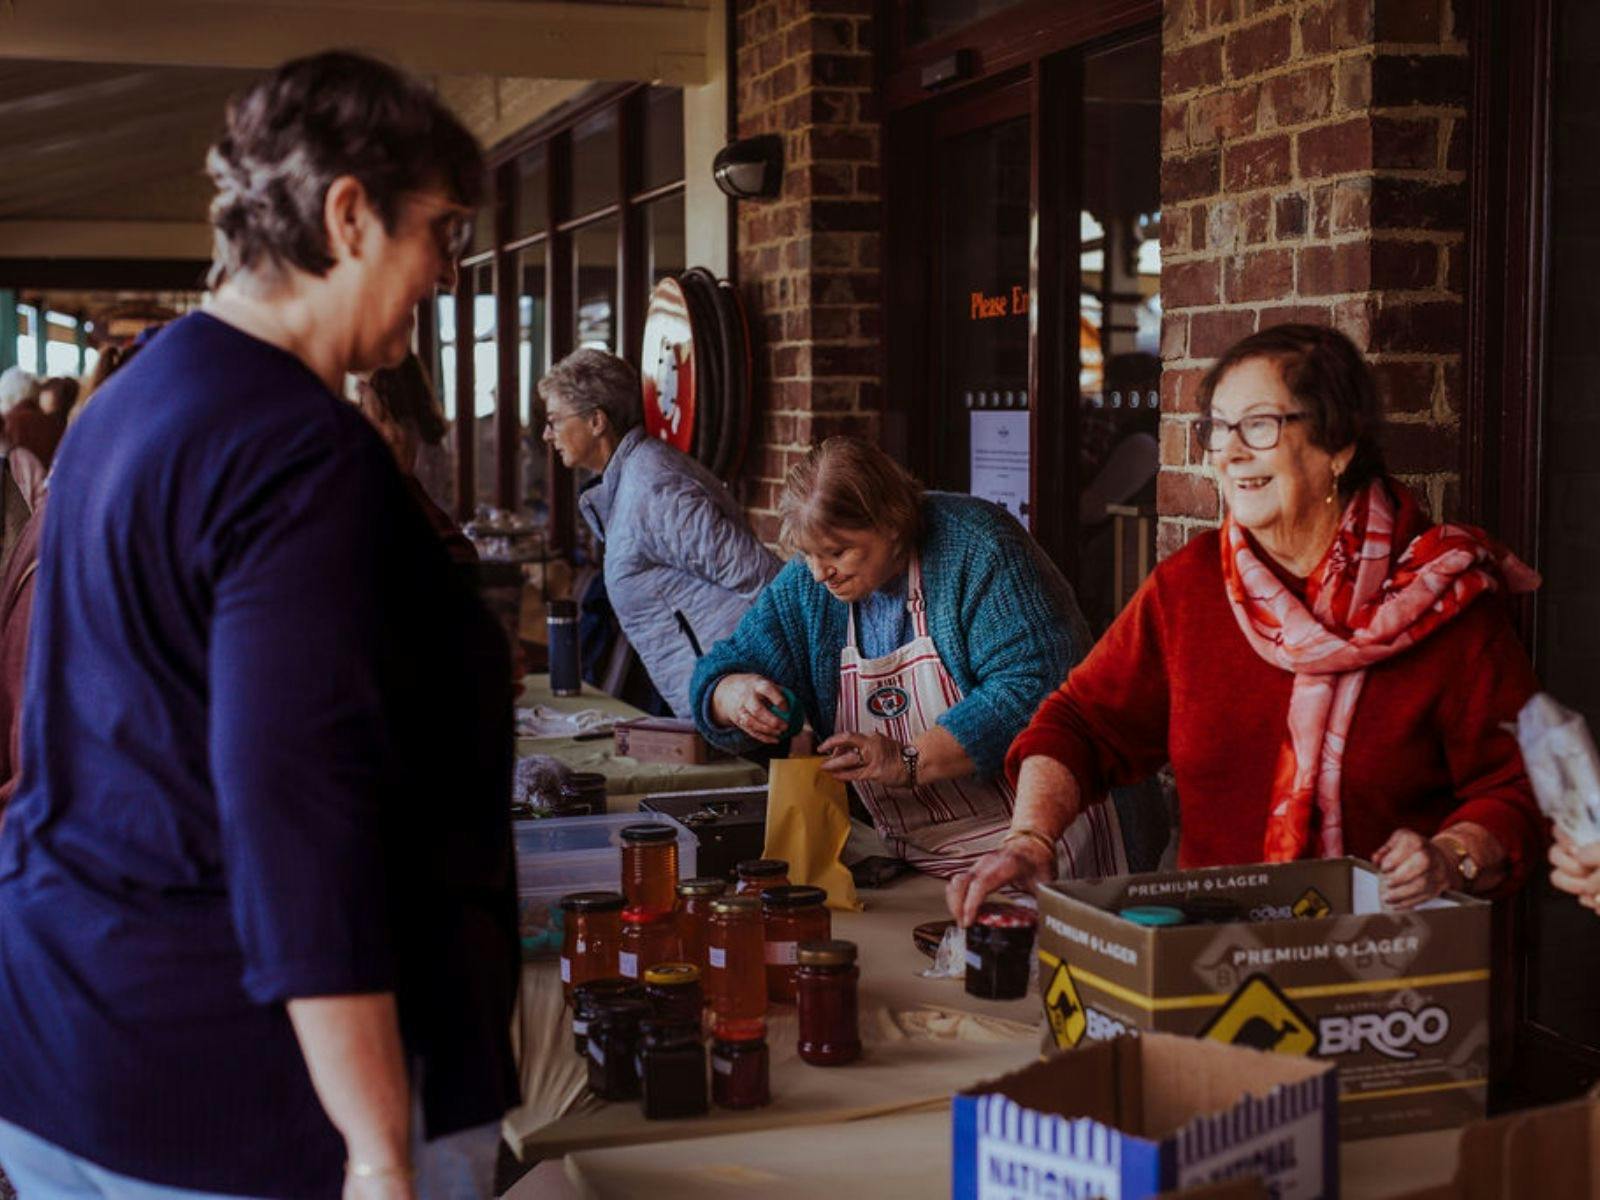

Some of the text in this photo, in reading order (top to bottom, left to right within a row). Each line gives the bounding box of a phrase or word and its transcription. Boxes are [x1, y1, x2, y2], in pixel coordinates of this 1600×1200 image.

[971, 292, 1006, 319] Please
[1128, 873, 1269, 897] PREMIUM LAGER
[1045, 915, 1137, 966] PREMIUM LAGER
[1233, 936, 1418, 966] PREMIUM LAGER
[1085, 1007, 1138, 1040] BRO
[1318, 1006, 1449, 1058] BROO
